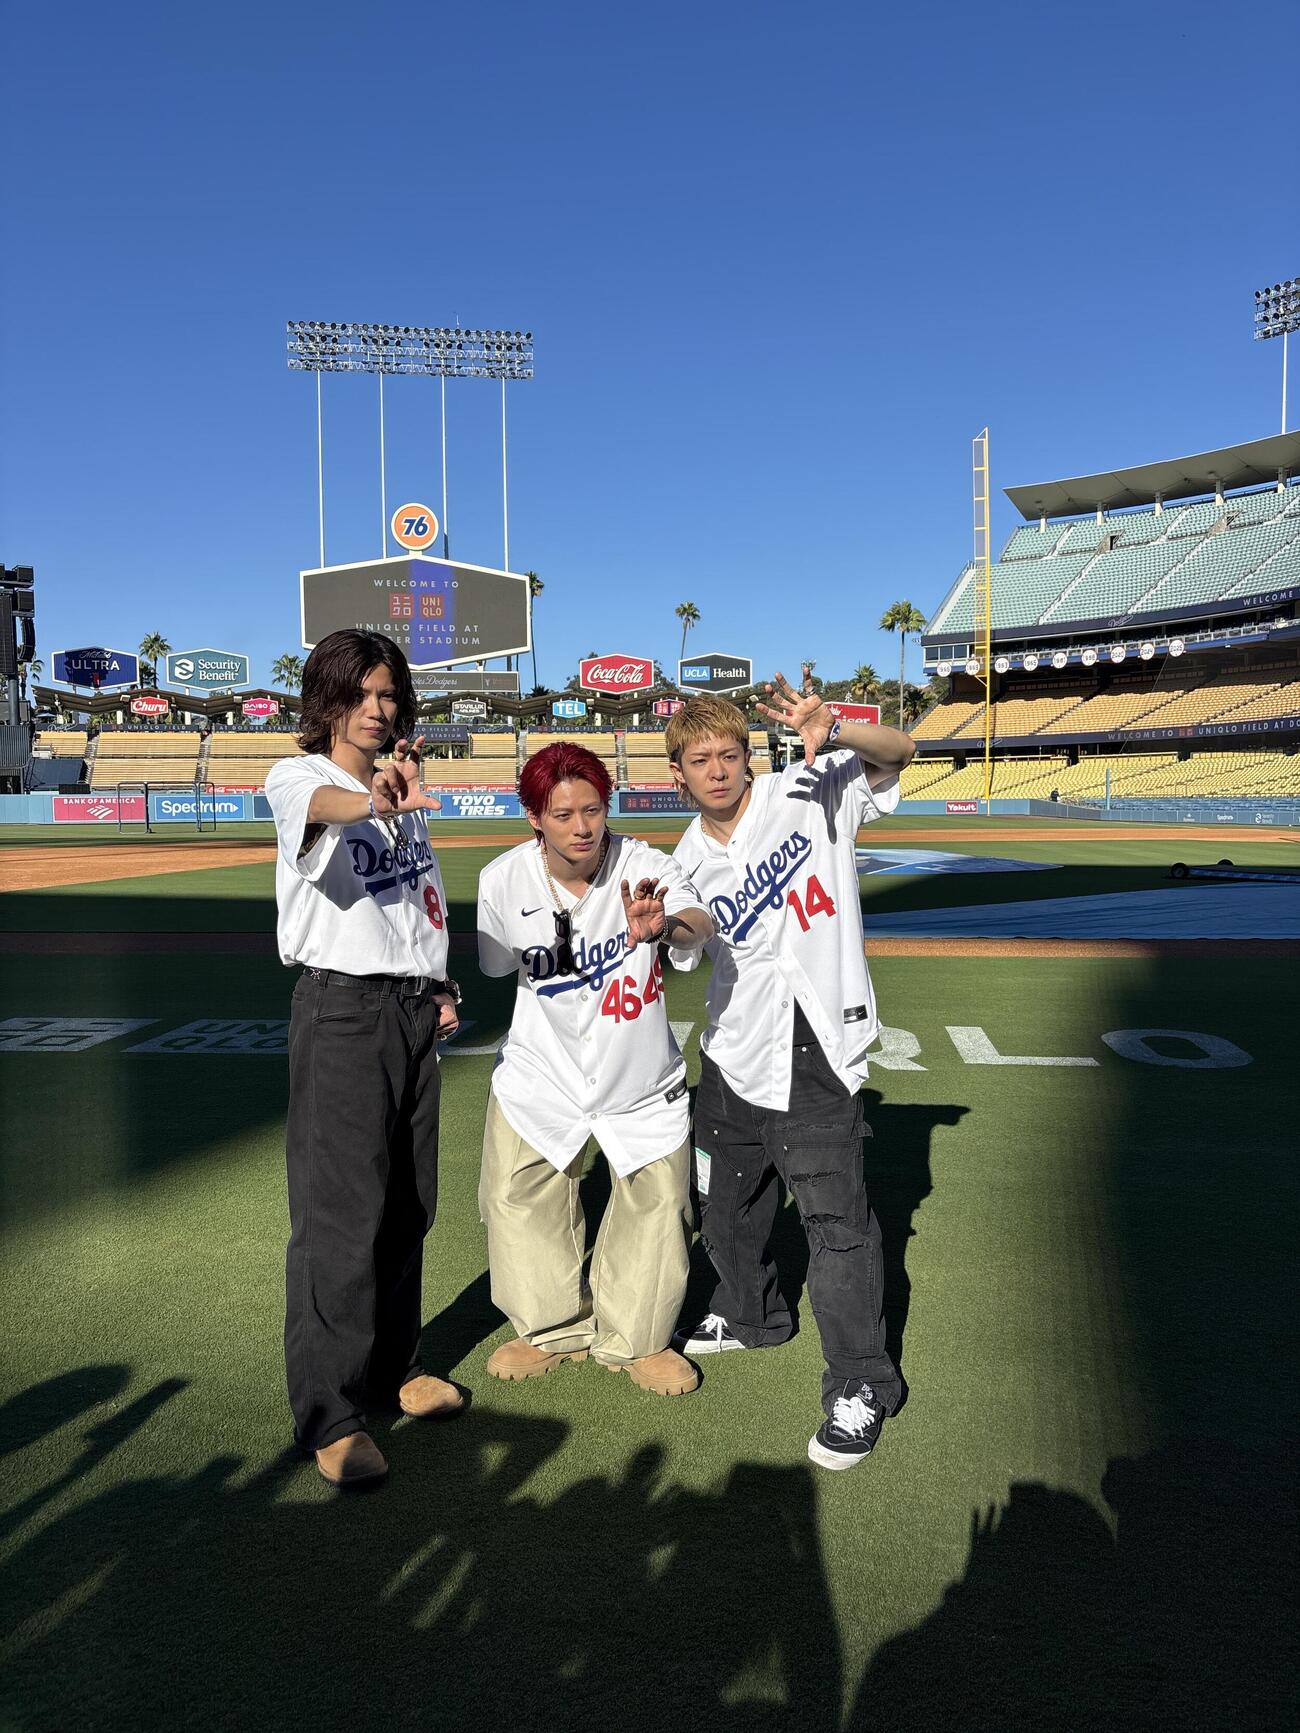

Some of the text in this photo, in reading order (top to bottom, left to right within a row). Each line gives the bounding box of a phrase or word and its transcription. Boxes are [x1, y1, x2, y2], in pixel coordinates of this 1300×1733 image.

[402, 515, 430, 537] 76
[374, 580, 436, 588] WELCOME
[422, 597, 441, 606] UNI
[1243, 591, 1293, 606] WELCOME
[422, 607, 443, 616] QLO
[355, 623, 410, 632] UNIQLO
[418, 624, 456, 632] FIELD
[419, 636, 481, 645] STADIUM
[71, 660, 120, 671] ULTRA
[198, 659, 241, 671] Security
[199, 670, 236, 681] Benefit
[586, 663, 646, 684] Coca-Cola
[684, 667, 746, 678] UCLA Health
[133, 701, 167, 711] Churu
[556, 703, 582, 715] TEL
[1108, 732, 1156, 740] WELCOME
[1199, 725, 1237, 735] UNIQLO
[1242, 723, 1269, 731] FIELD
[1274, 721, 1284, 729] AT
[452, 795, 495, 806] TOYO
[161, 800, 233, 816] Spectrum
[459, 805, 506, 816] TIRES
[346, 838, 433, 891] Dodgers
[709, 830, 812, 936] Dodgers
[423, 885, 444, 930] 8
[787, 874, 836, 932] 14
